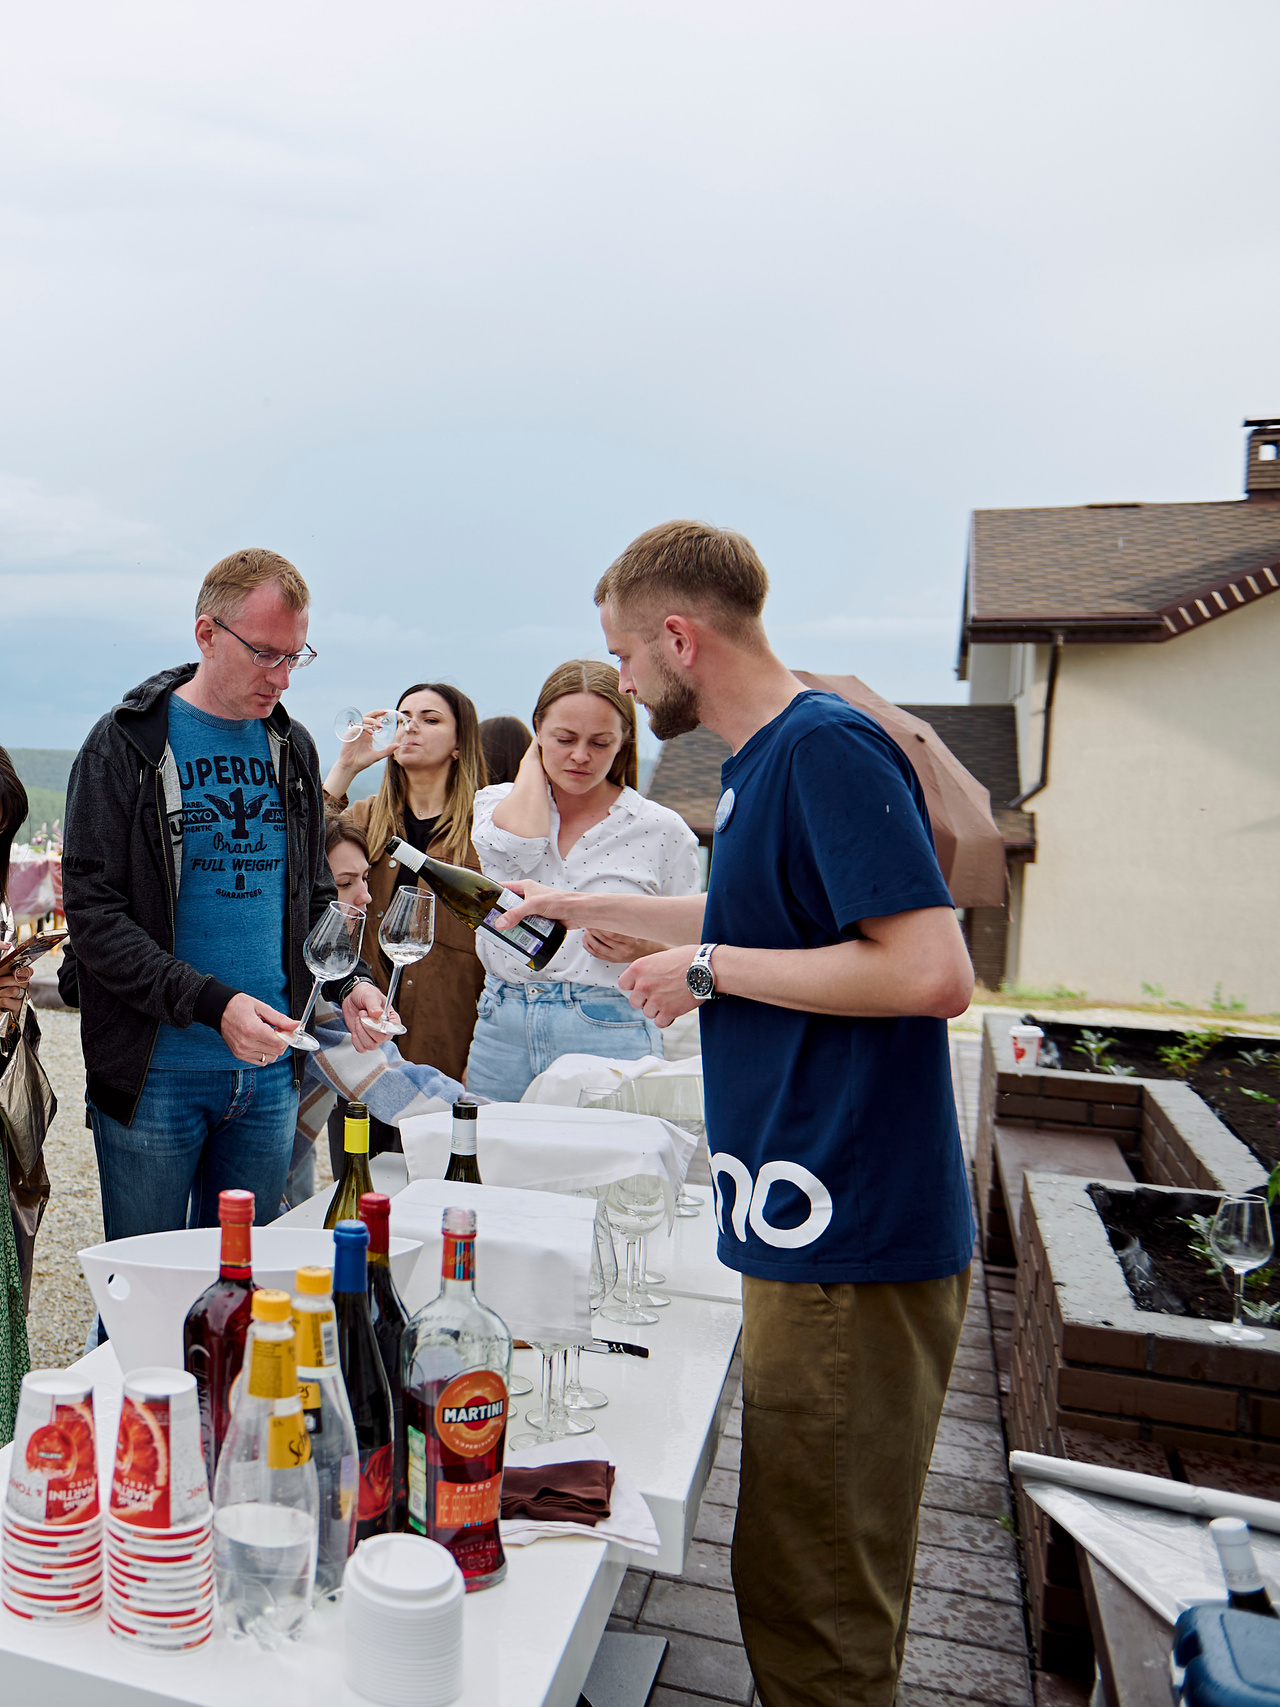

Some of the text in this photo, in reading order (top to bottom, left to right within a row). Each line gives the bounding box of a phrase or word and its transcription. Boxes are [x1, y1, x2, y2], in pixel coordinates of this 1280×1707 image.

[176, 755, 279, 791] UPERDR
[182, 801, 205, 809] PAREL
[213, 831, 268, 854] Brand
[215, 887, 263, 899] GUARANTEED
[443, 1400, 504, 1423] MARTINI
[456, 1481, 492, 1493] FIERO
